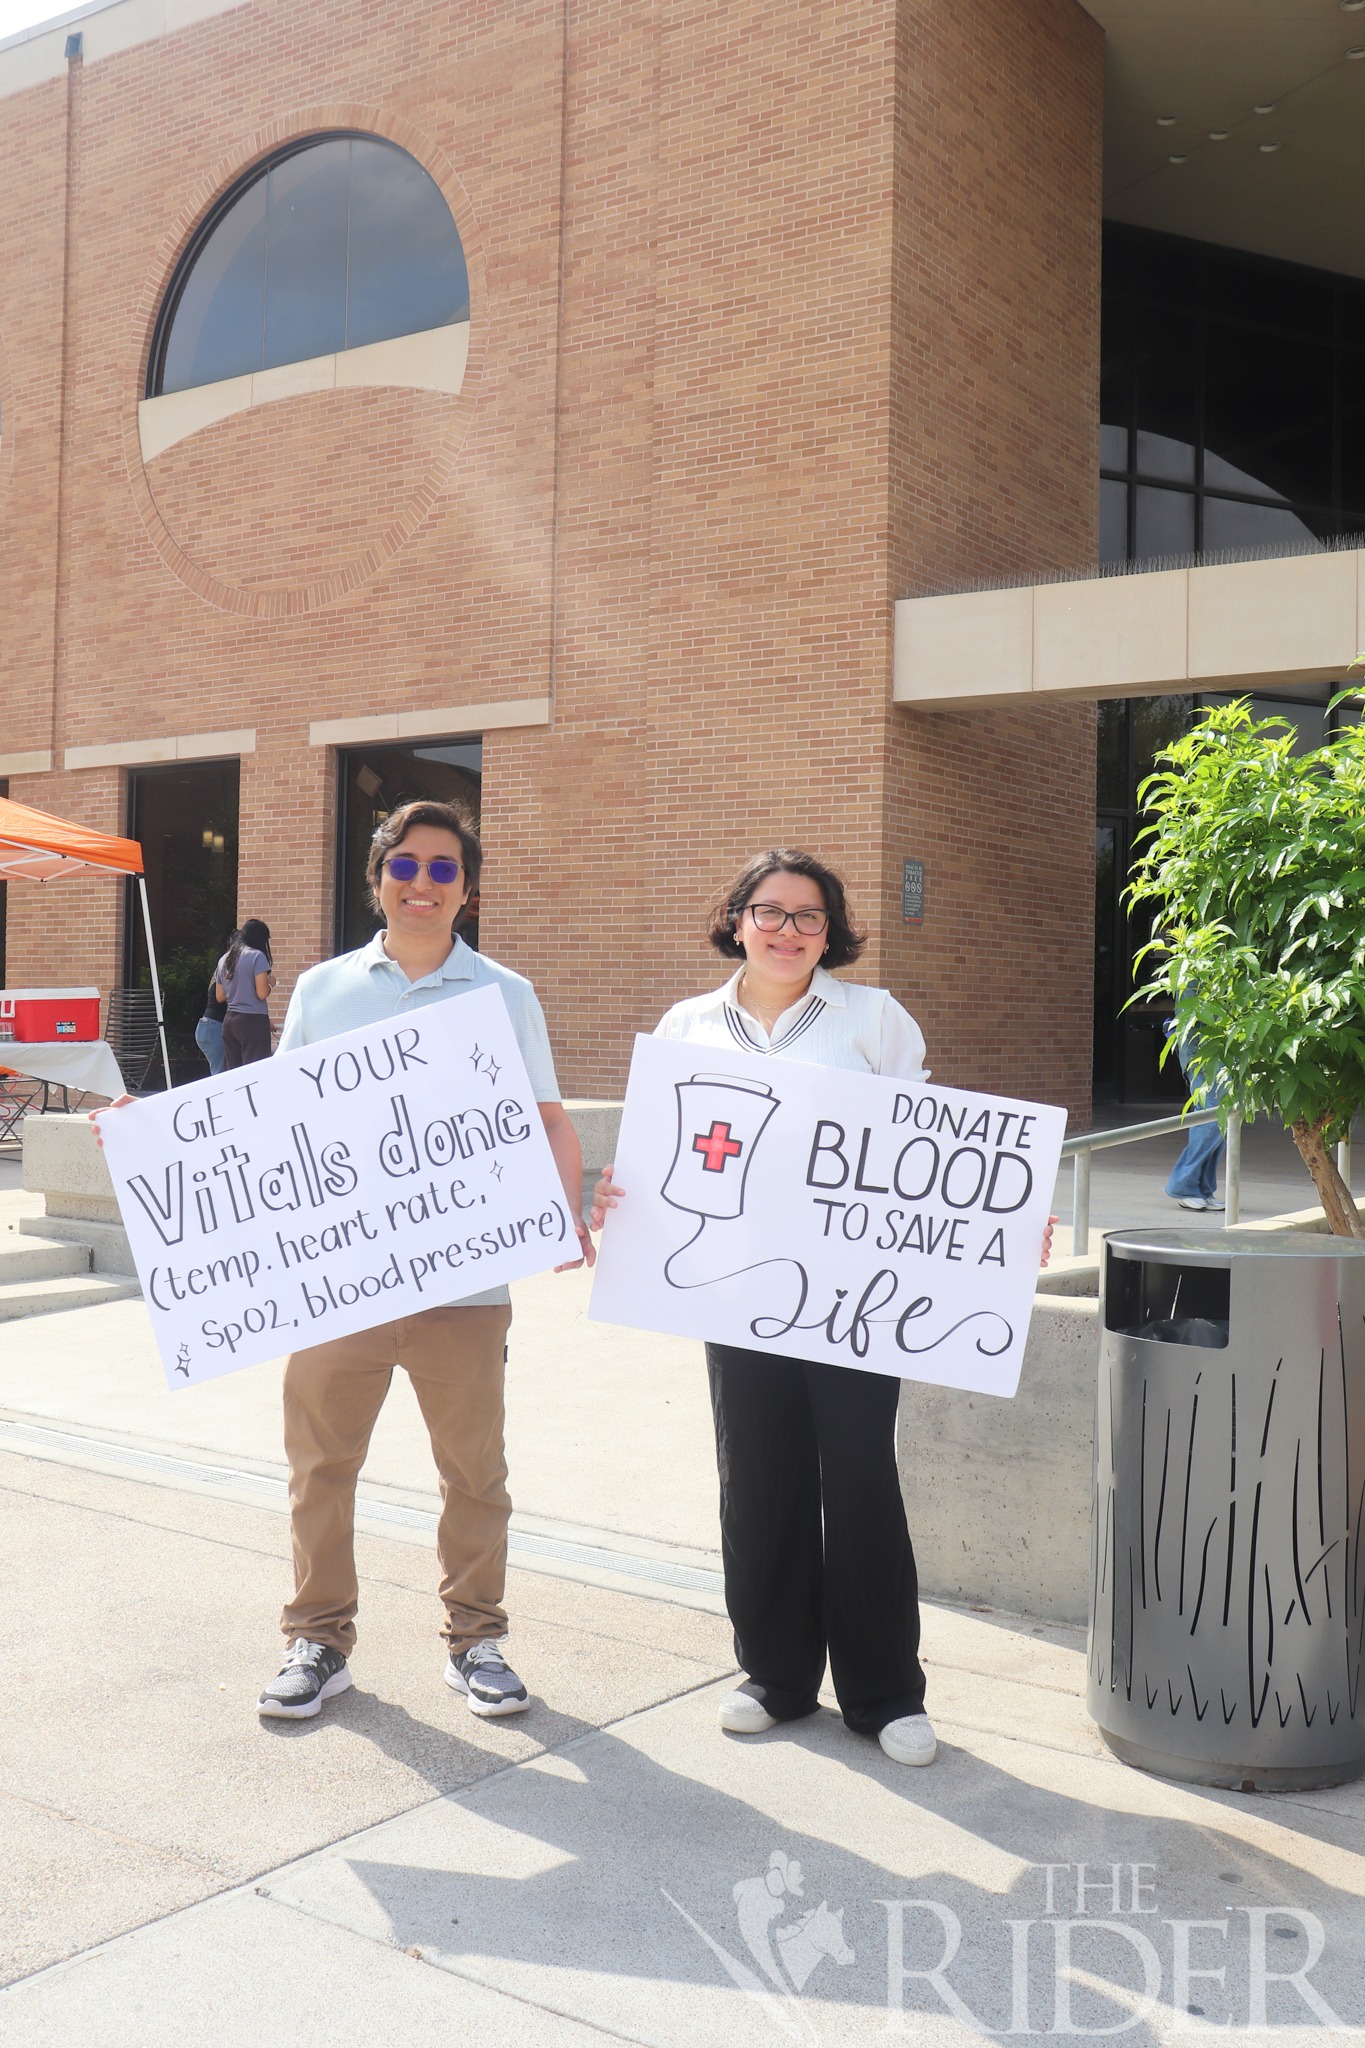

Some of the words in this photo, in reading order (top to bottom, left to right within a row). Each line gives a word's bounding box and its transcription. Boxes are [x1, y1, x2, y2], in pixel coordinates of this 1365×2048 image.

[173, 1081, 259, 1142] GET
[300, 1028, 428, 1099] YOUR
[892, 1093, 1036, 1149] DONATE
[127, 1122, 358, 1246] Vitals
[379, 1094, 531, 1178] done
[807, 1120, 1033, 1213] BLOOD
[149, 1249, 272, 1310] (temp.
[276, 1209, 378, 1269] heart
[300, 1253, 405, 1319] blood
[408, 1200, 568, 1292] pressure)
[813, 1199, 869, 1240] TO
[877, 1209, 969, 1261] SAVE
[978, 1228, 1005, 1267] A
